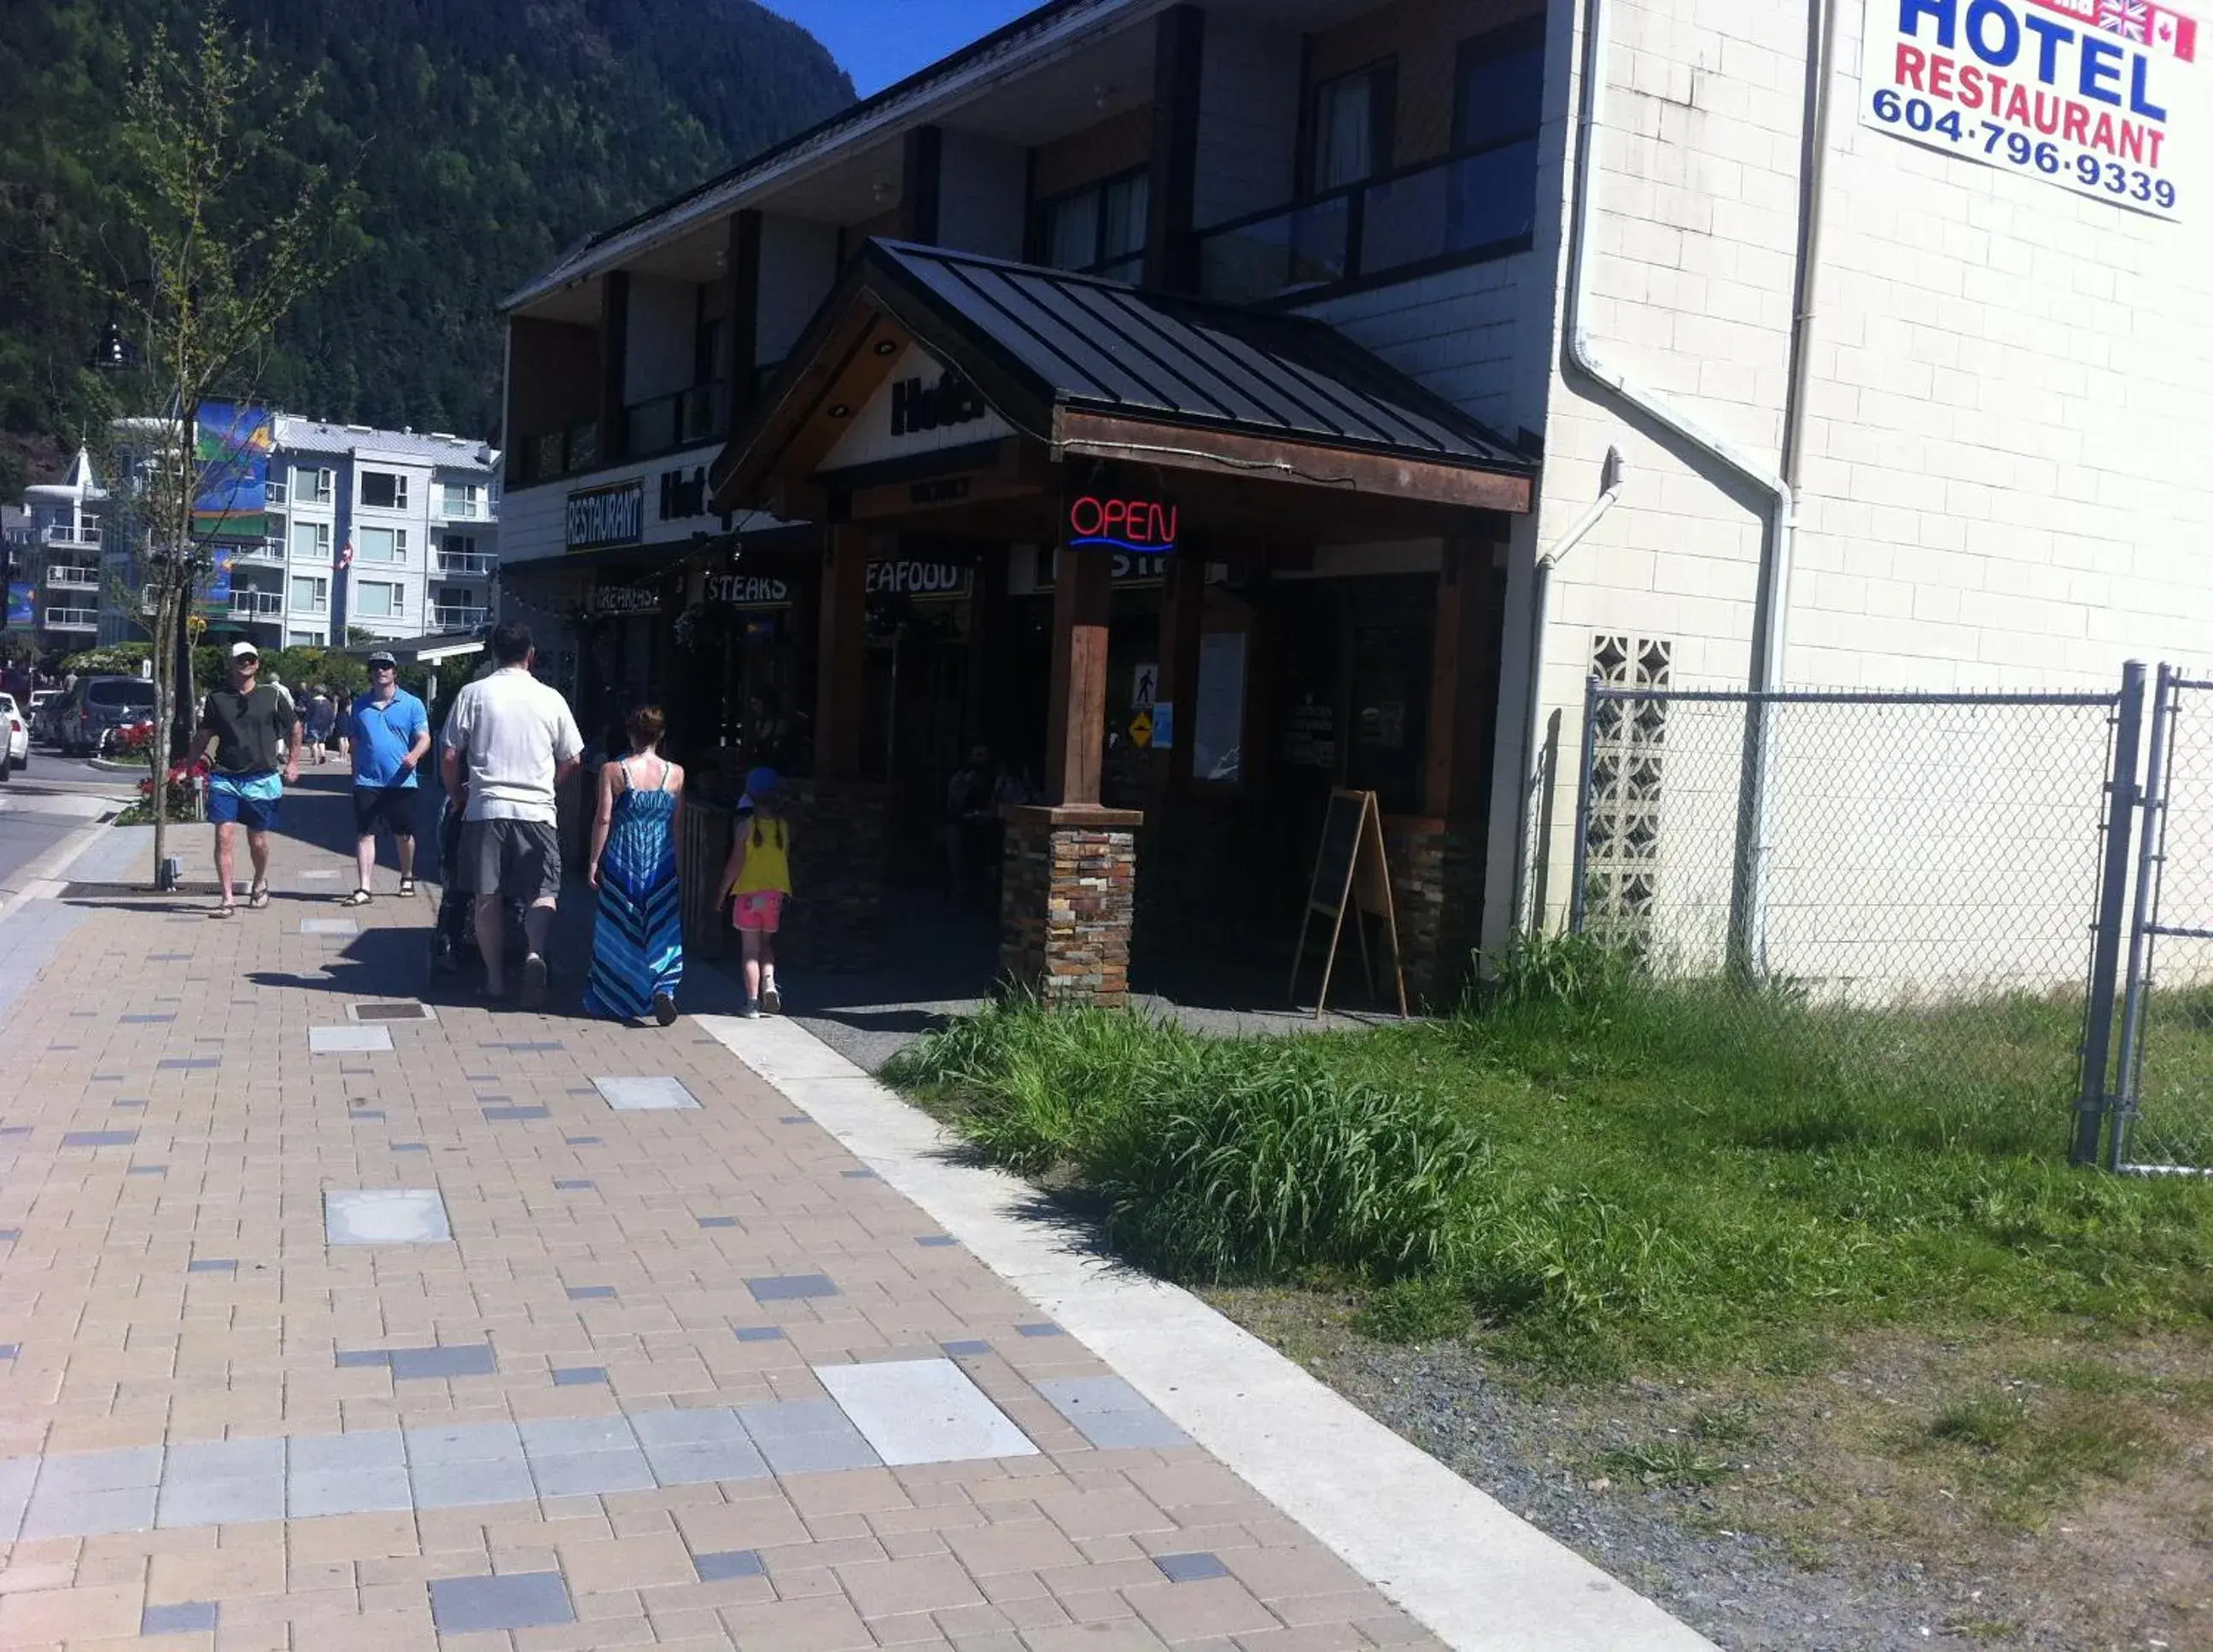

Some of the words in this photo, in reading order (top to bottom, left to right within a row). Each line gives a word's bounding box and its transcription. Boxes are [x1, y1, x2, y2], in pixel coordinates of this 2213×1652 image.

[1899, 0, 2168, 124] HOTEL
[1895, 42, 2164, 169] RESTAURANT
[567, 487, 642, 545] RESTAURANT
[1070, 495, 1179, 544] OPEN
[865, 561, 958, 594] EAFOOD
